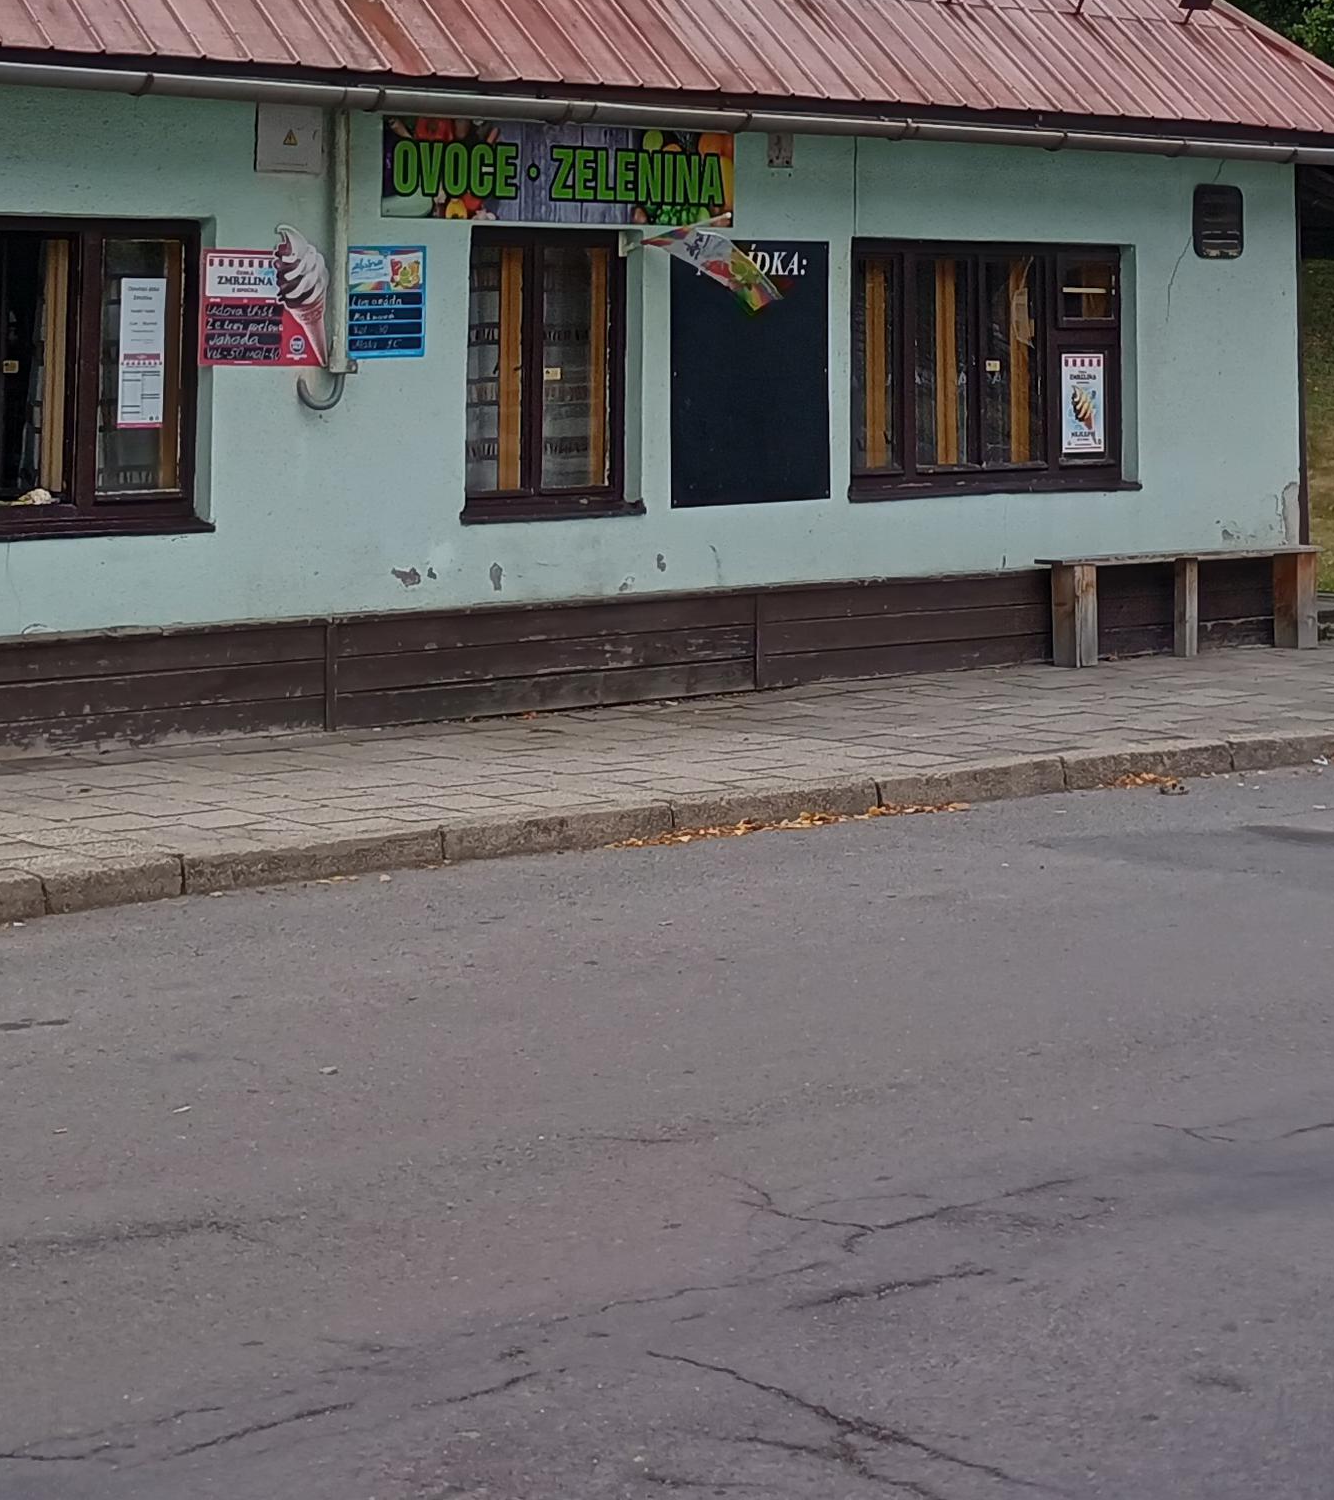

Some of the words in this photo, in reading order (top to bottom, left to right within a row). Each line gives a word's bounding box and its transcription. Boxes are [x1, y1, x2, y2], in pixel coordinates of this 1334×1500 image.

[392, 140, 517, 198] OVOCE
[550, 148, 724, 205] ZELENINA
[217, 275, 274, 286] ZMRZLINA
